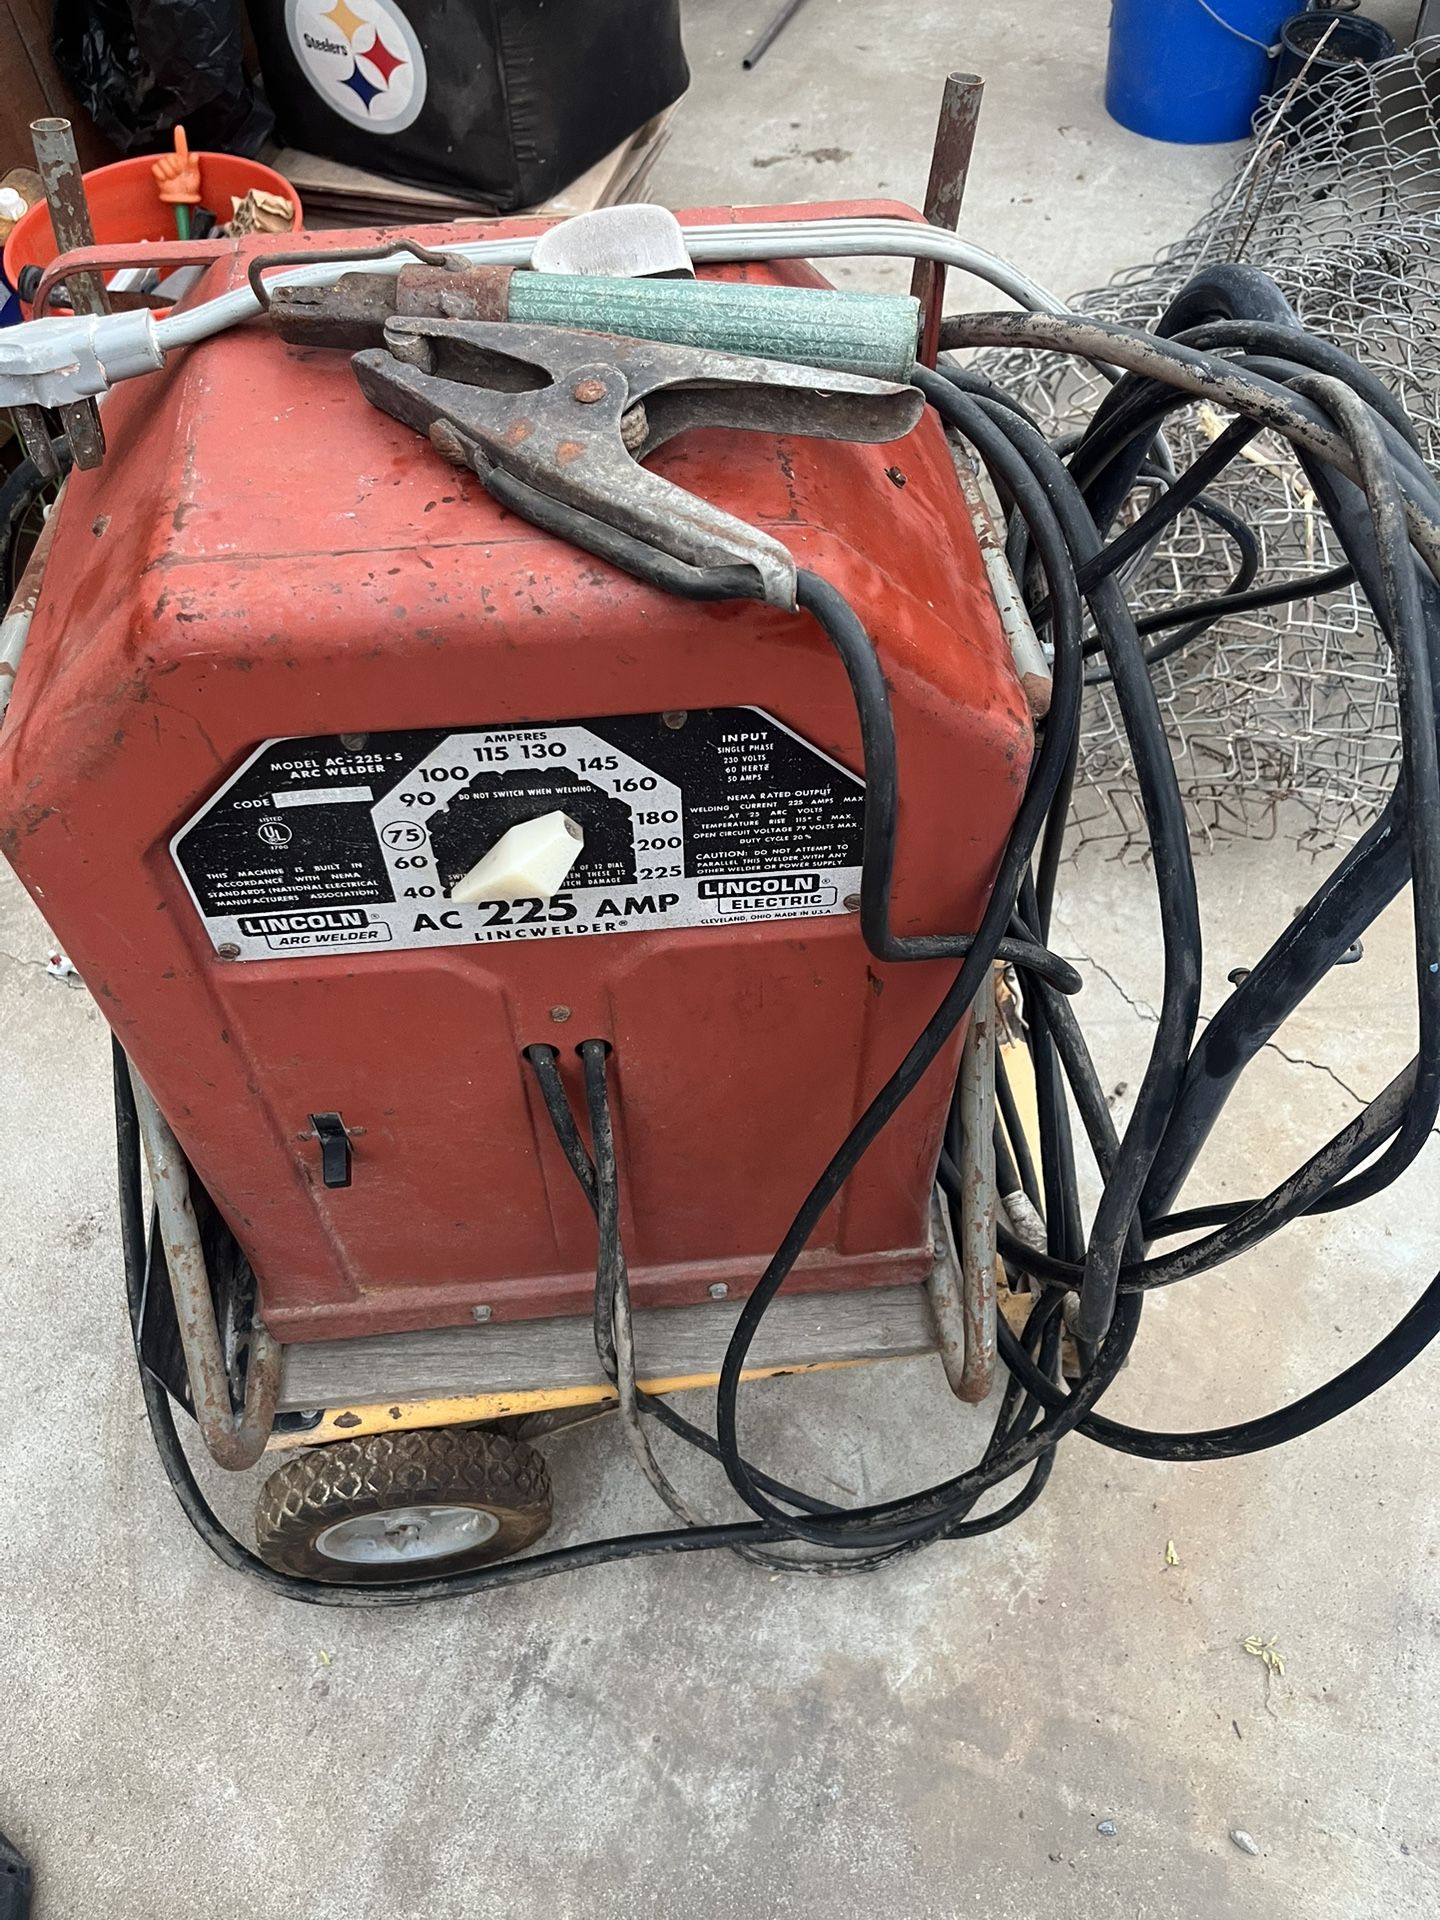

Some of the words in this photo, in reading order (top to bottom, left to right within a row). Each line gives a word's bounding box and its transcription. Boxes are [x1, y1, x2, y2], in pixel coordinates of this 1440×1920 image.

[304, 33, 348, 56] Steelers
[484, 732, 548, 743] AMPERES
[722, 732, 768, 742] INPUT
[473, 747, 509, 761] 115
[520, 743, 567, 759] 130
[718, 746, 745, 754] SINGLE
[750, 743, 774, 752] PHASE
[270, 760, 319, 771] MODEL
[578, 757, 618, 772] 145
[290, 769, 321, 779] ARC
[325, 765, 385, 776] WELDER
[419, 767, 469, 783] 100
[613, 777, 657, 792] 160
[399, 792, 436, 807] 90
[493, 790, 524, 798] SWITCH
[527, 788, 552, 796] WHEN
[727, 793, 756, 801] NEMA
[795, 788, 831, 797] OUTPUT
[233, 799, 271, 810] CODE
[690, 805, 730, 813] WELDING
[740, 802, 777, 810] CURRENT
[637, 810, 678, 825] 180
[701, 820, 759, 829] TEMPERATURE
[264, 826, 286, 840] UL
[388, 828, 419, 843] 75
[693, 831, 716, 839] OPEN
[754, 826, 792, 834] VOLTAGE
[637, 837, 682, 851] 200
[696, 850, 748, 860] CAUTION:
[394, 856, 429, 869] 60
[697, 860, 738, 868] PARALLEL
[779, 861, 810, 869] POWER
[238, 868, 285, 877] MACHINE
[640, 865, 682, 880] 225
[217, 877, 283, 888] ACCORDANCE
[331, 872, 361, 880] NEMA
[704, 877, 813, 895] LINCOLN
[208, 888, 265, 898] STANDARDS
[268, 884, 324, 894] (NATIONAL
[325, 880, 379, 890] ELECTRICAL
[403, 886, 436, 898] 40
[216, 895, 299, 906] MANUFACTURERS
[310, 889, 379, 899] ASSOCIATION)
[732, 895, 822, 910] ELECTRIC
[413, 910, 462, 932] AC
[477, 893, 578, 927] 225
[595, 894, 680, 918] AMP
[701, 915, 748, 924] CLEVELAND,
[751, 912, 771, 920] OHIO
[244, 912, 362, 933] LINCOLN
[279, 936, 310, 945] ARC
[316, 931, 378, 942] WELDER
